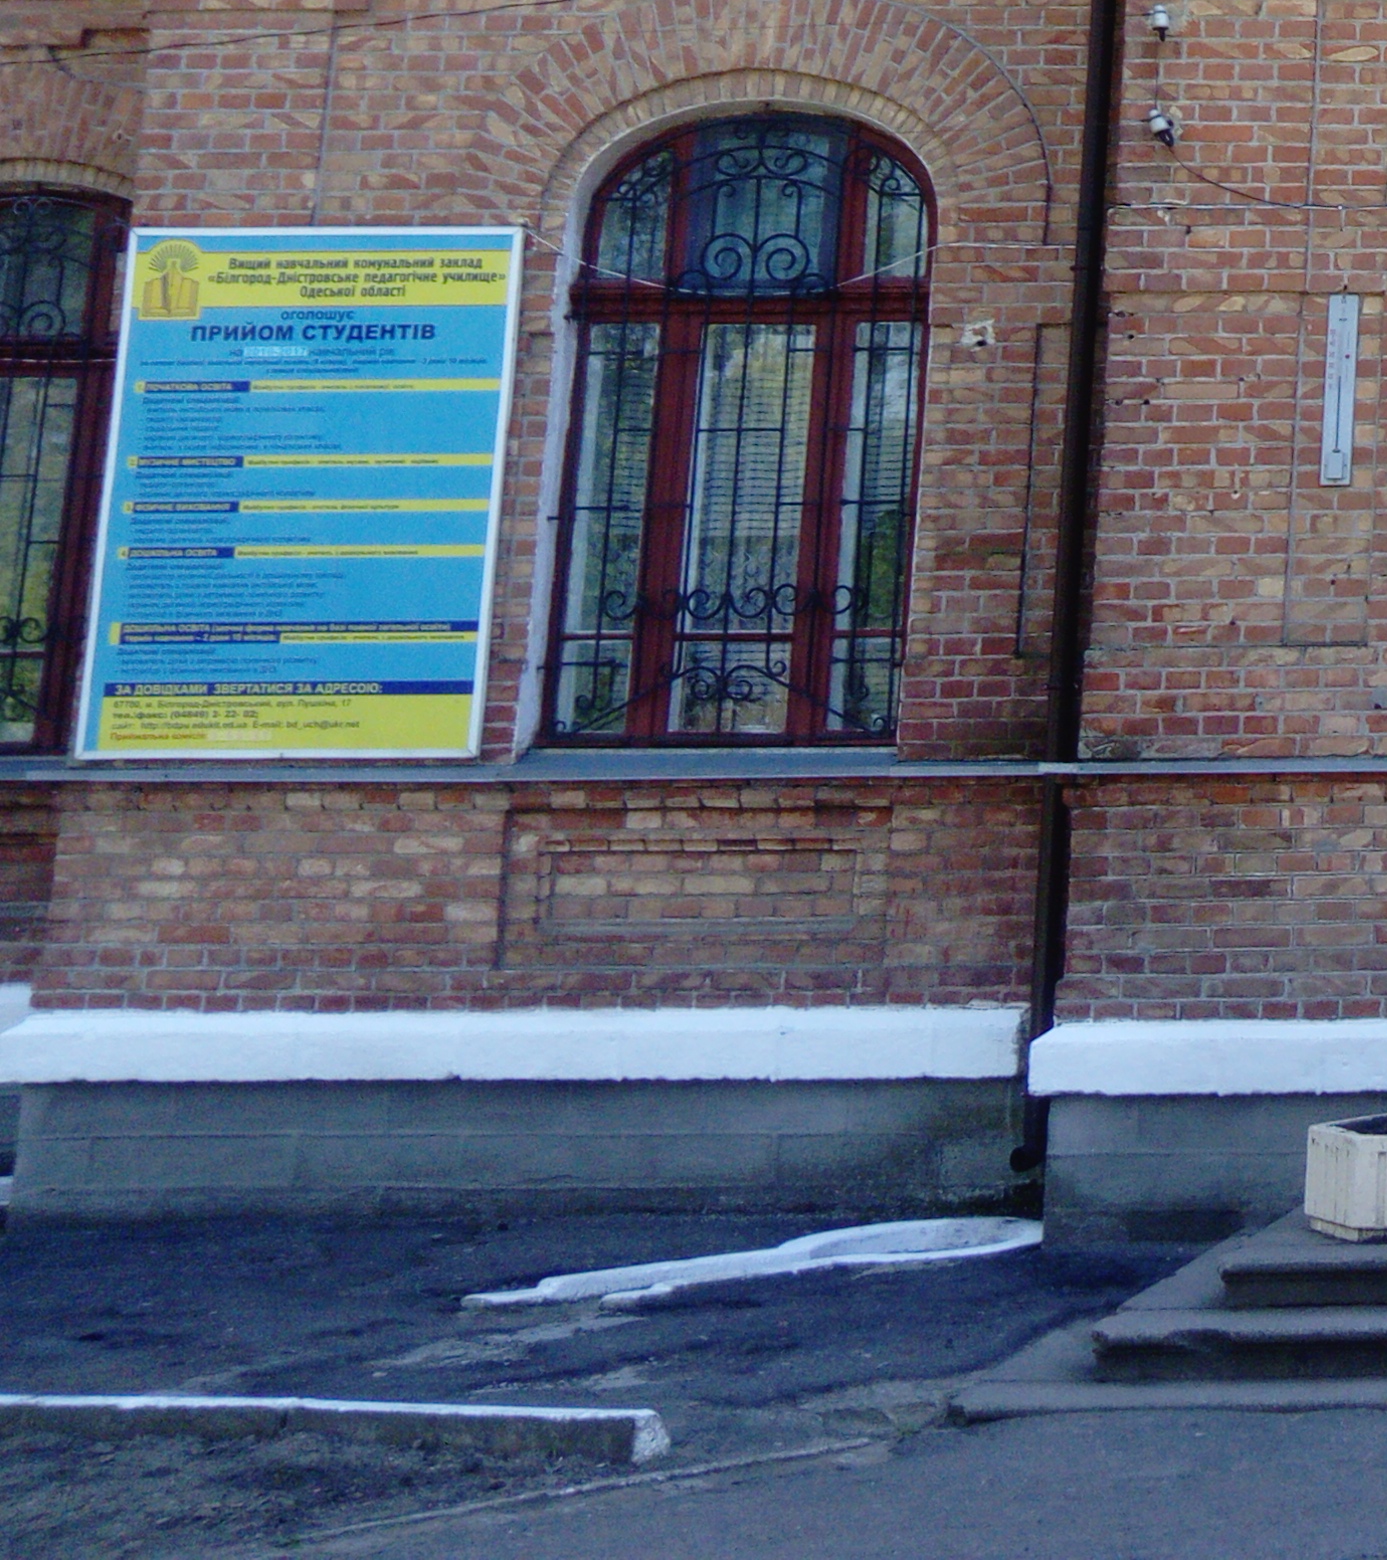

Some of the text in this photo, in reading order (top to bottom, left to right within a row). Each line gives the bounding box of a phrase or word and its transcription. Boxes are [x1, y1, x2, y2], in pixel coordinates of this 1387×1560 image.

[228, 257, 483, 271] Вищий навчальний комунальний заклад
[208, 271, 506, 285] «Білгород-Дністровське педагогічне училище»
[299, 285, 406, 298] Одеської області
[280, 310, 354, 322] оголошує
[190, 321, 436, 343] ПРИЙОМ СТУДЕНТІВ
[114, 682, 383, 696] ЗА ДОВІДКАМИ ЗВЕРТАТИСЯ ЗА АДРЕСОЮ:
